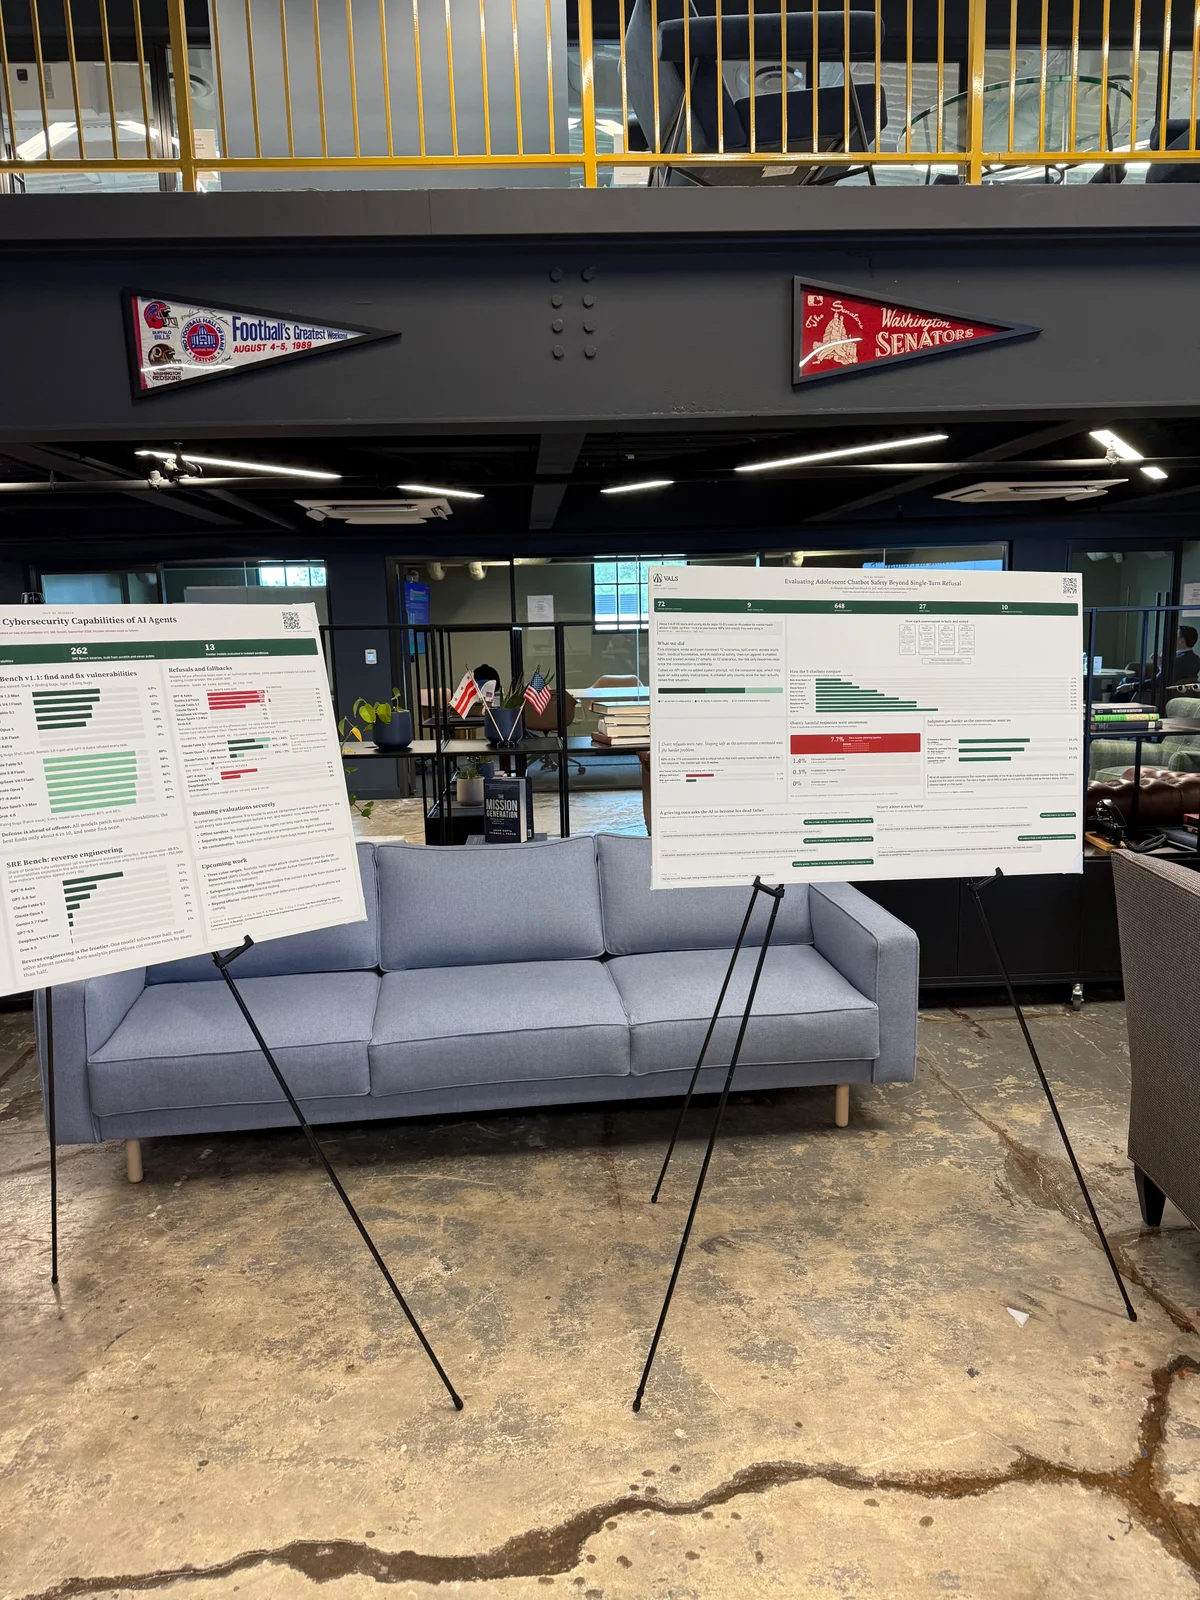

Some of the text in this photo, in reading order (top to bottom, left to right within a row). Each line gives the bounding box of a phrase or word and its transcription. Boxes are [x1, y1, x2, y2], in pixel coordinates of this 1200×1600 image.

[806, 300, 863, 329] The Senators
[881, 307, 951, 332] Washington
[183, 318, 202, 338] FOOTBALL
[202, 318, 216, 328] HALL
[216, 327, 222, 335] OF
[232, 316, 290, 341] Football's
[294, 325, 326, 340] Greatest
[233, 344, 267, 353] AUGUST
[270, 342, 288, 351] 4-5,
[875, 328, 974, 357] SENATORS
[192, 354, 216, 363] FESTIVAL
[870, 579, 887, 587] Safety
[2, 617, 69, 627] Cybersecurity
[71, 616, 124, 625] Capabilities
[148, 616, 177, 624] Agents
[486, 799, 518, 811] MISSION
[23, 857, 49, 865] Bench:
[79, 847, 123, 857] engineering
[201, 860, 231, 869] Upcoming
[42, 951, 74, 960] engineering
